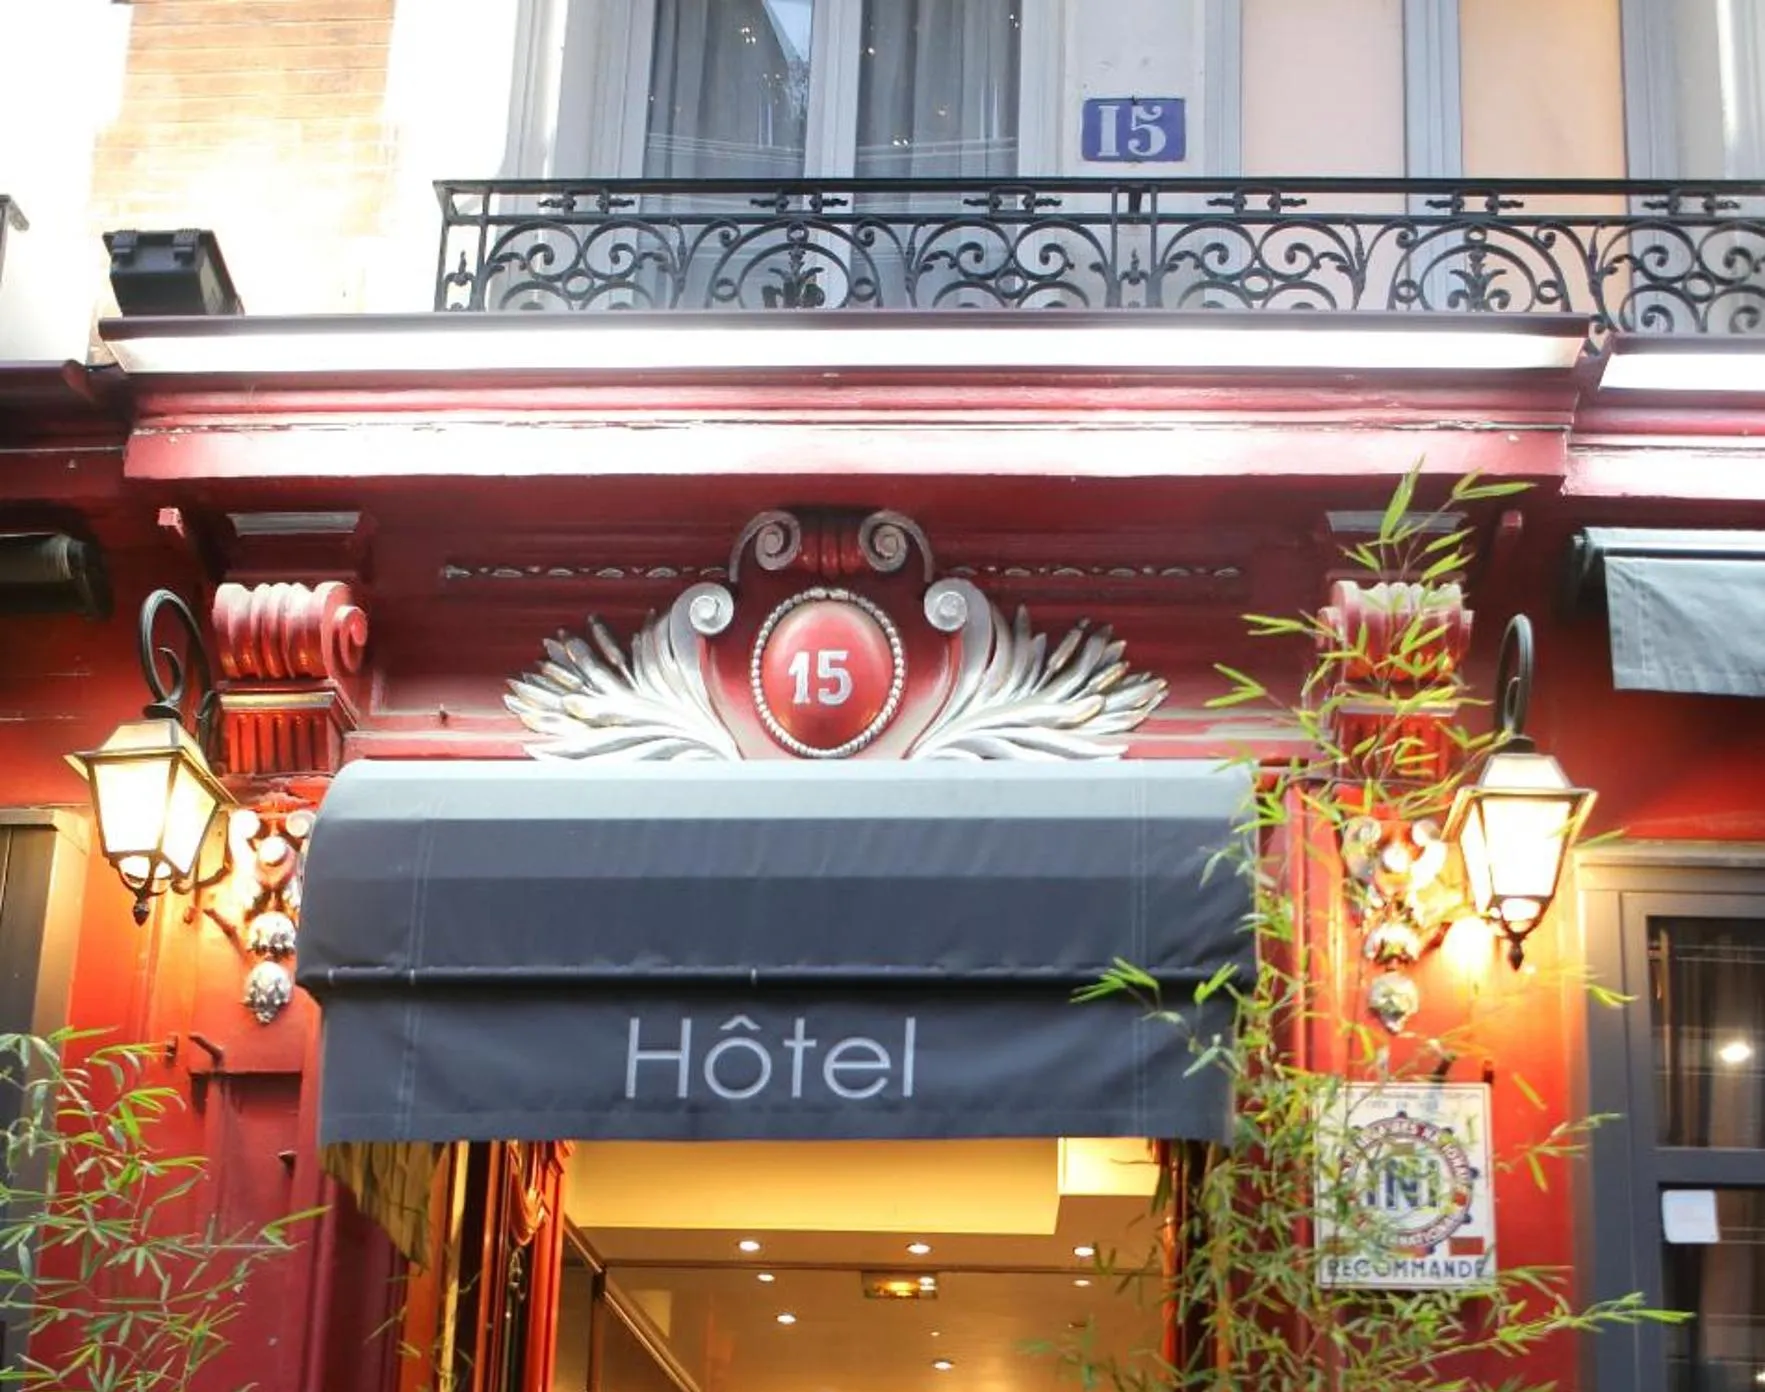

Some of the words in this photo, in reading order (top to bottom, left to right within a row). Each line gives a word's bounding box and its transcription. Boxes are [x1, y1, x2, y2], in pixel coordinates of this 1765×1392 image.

[1097, 105, 1167, 157] 15
[788, 649, 852, 706] 15
[625, 1014, 916, 1100] Hôtel
